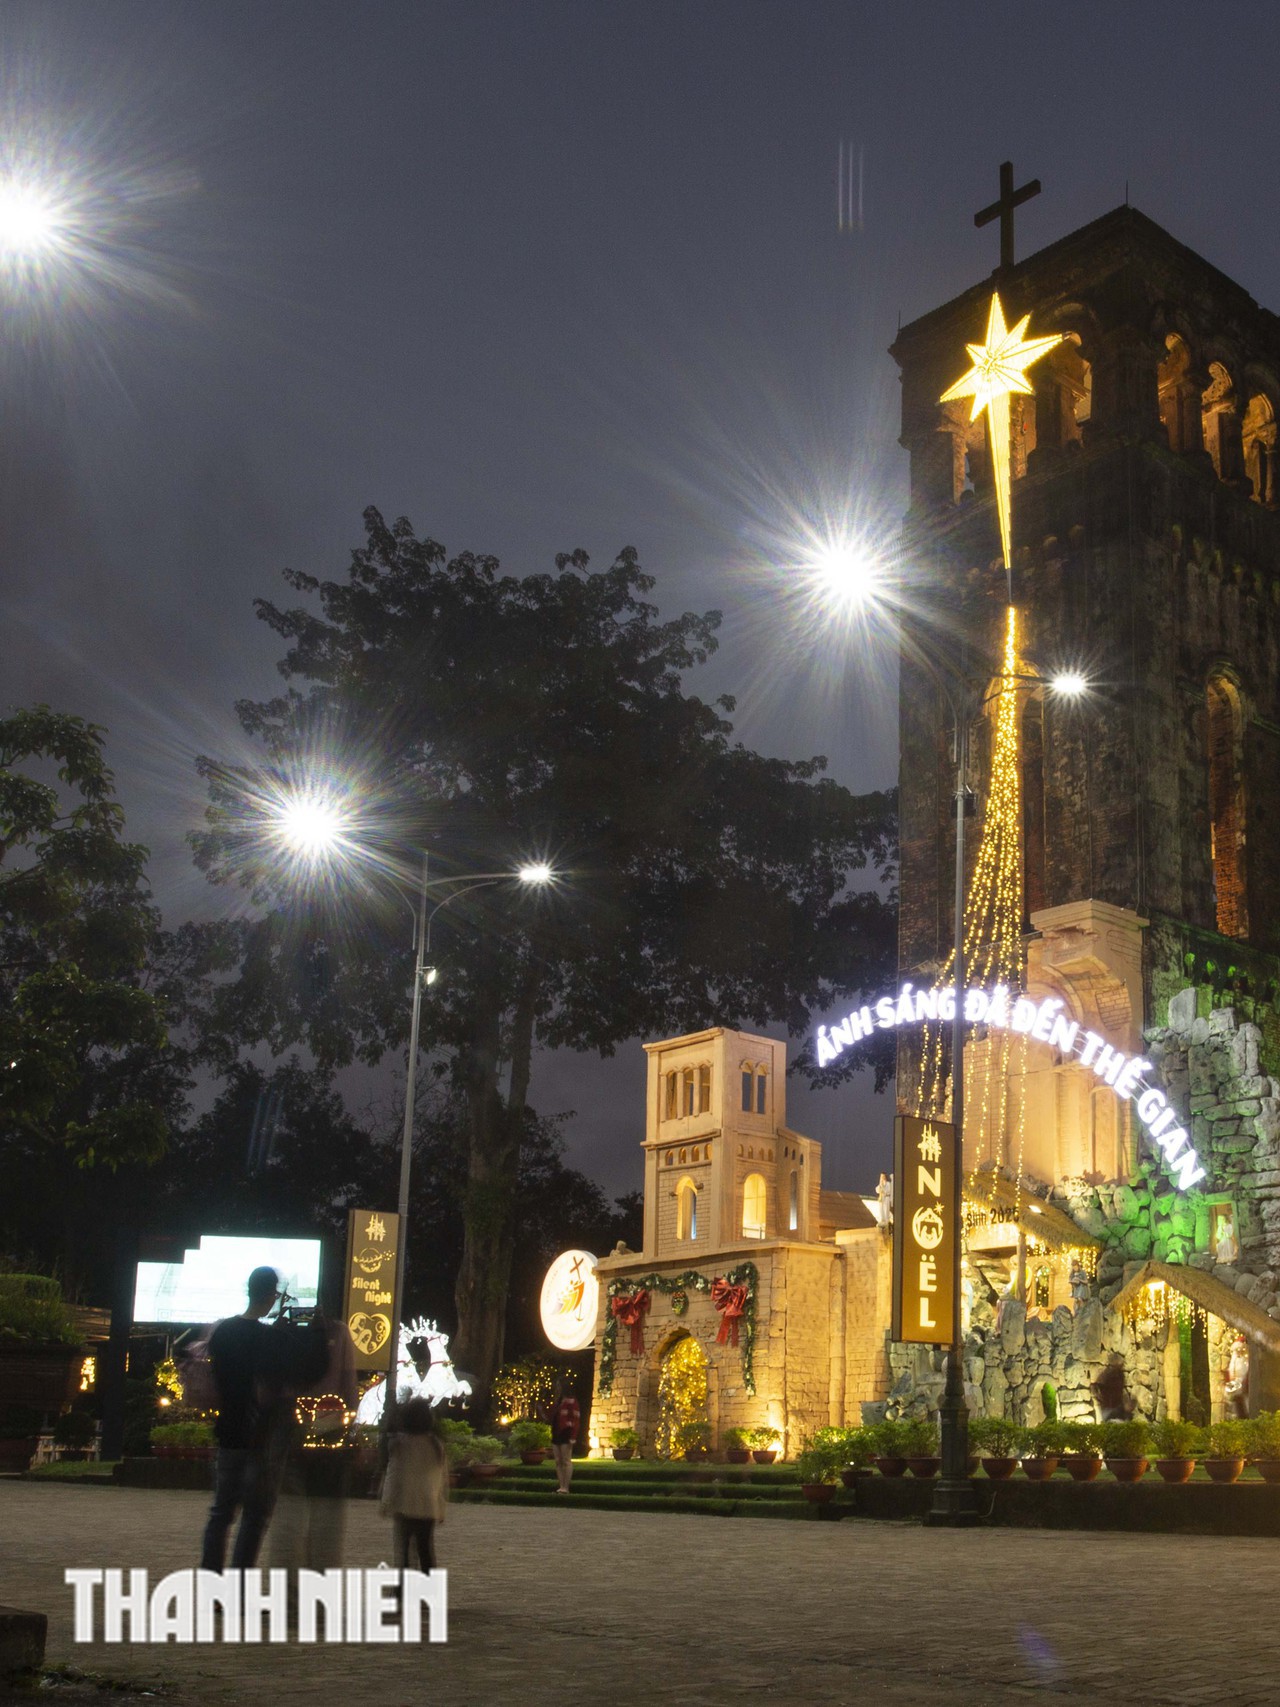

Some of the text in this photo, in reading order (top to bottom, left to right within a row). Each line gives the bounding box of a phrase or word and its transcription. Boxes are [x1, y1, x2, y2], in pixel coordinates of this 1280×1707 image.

[816, 1005, 874, 1068] ÁNH
[876, 983, 956, 1029] SÁNG
[1011, 998, 1079, 1053] ĐẾN
[1080, 1031, 1153, 1099] THẾ
[1137, 1088, 1206, 1191] GIAN
[352, 1277, 380, 1290] Silent
[364, 1290, 392, 1306] Night
